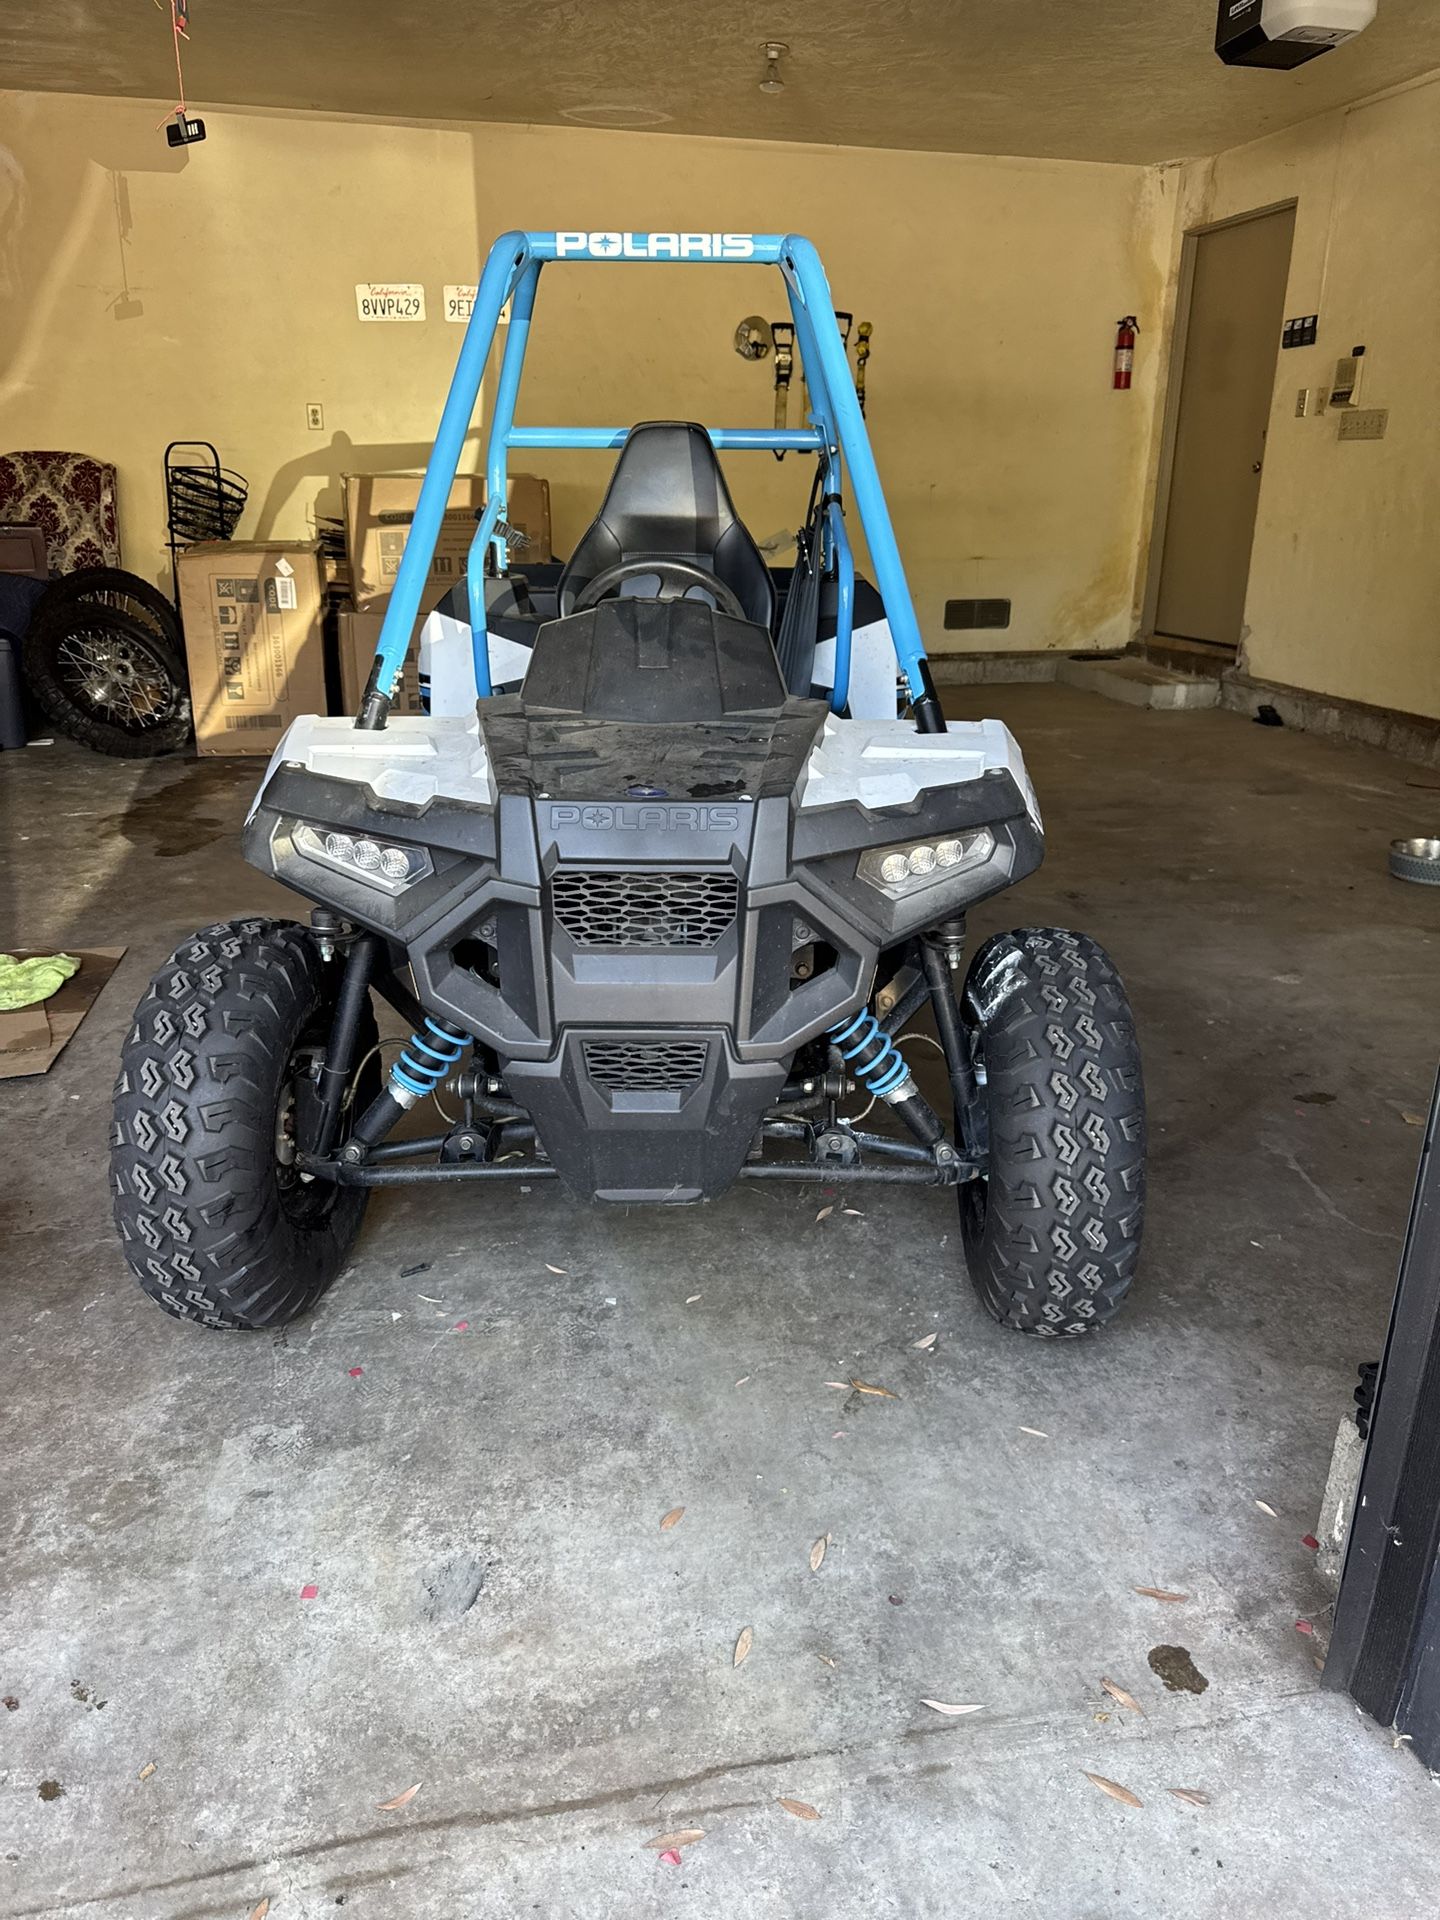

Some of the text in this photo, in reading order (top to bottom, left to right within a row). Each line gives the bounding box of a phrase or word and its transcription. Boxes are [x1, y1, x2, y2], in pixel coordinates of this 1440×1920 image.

[556, 232, 754, 257] POLARIS
[371, 287, 407, 297] California
[362, 298, 420, 315] 8VVP429
[268, 584, 278, 609] CODE
[551, 806, 738, 831] POLARIS
